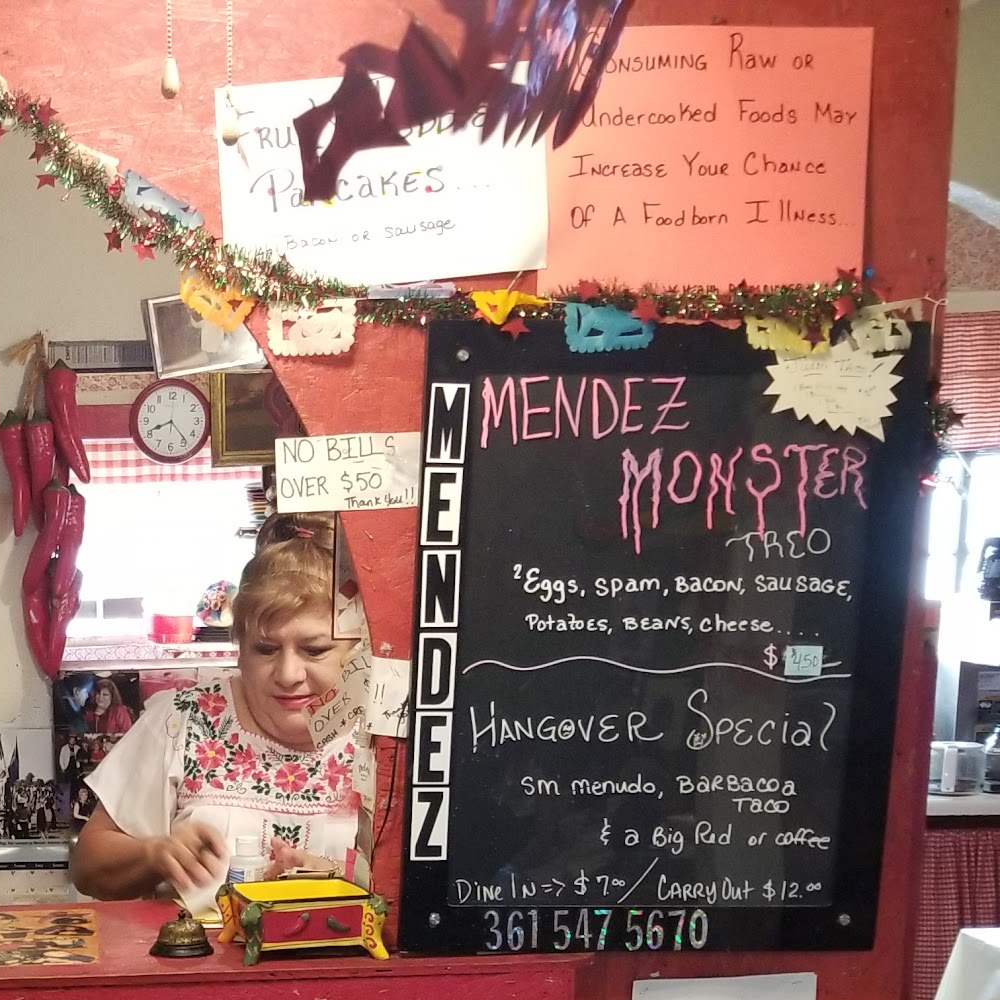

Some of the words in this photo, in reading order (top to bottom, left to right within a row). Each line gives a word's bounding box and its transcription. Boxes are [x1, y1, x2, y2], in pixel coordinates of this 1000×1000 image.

[738, 99, 797, 125] Foods
[613, 206, 626, 225] A
[480, 375, 691, 449] MENDEZ
[282, 440, 315, 464] NO
[325, 436, 397, 462] BILLS
[280, 475, 329, 499] OVER
[340, 470, 383, 494] $50
[618, 443, 869, 555] MONSTER
[747, 831, 768, 847] or
[775, 828, 831, 850] coffee
[484, 910, 538, 951] 361
[552, 909, 613, 951] 547
[624, 908, 710, 951] 5670
